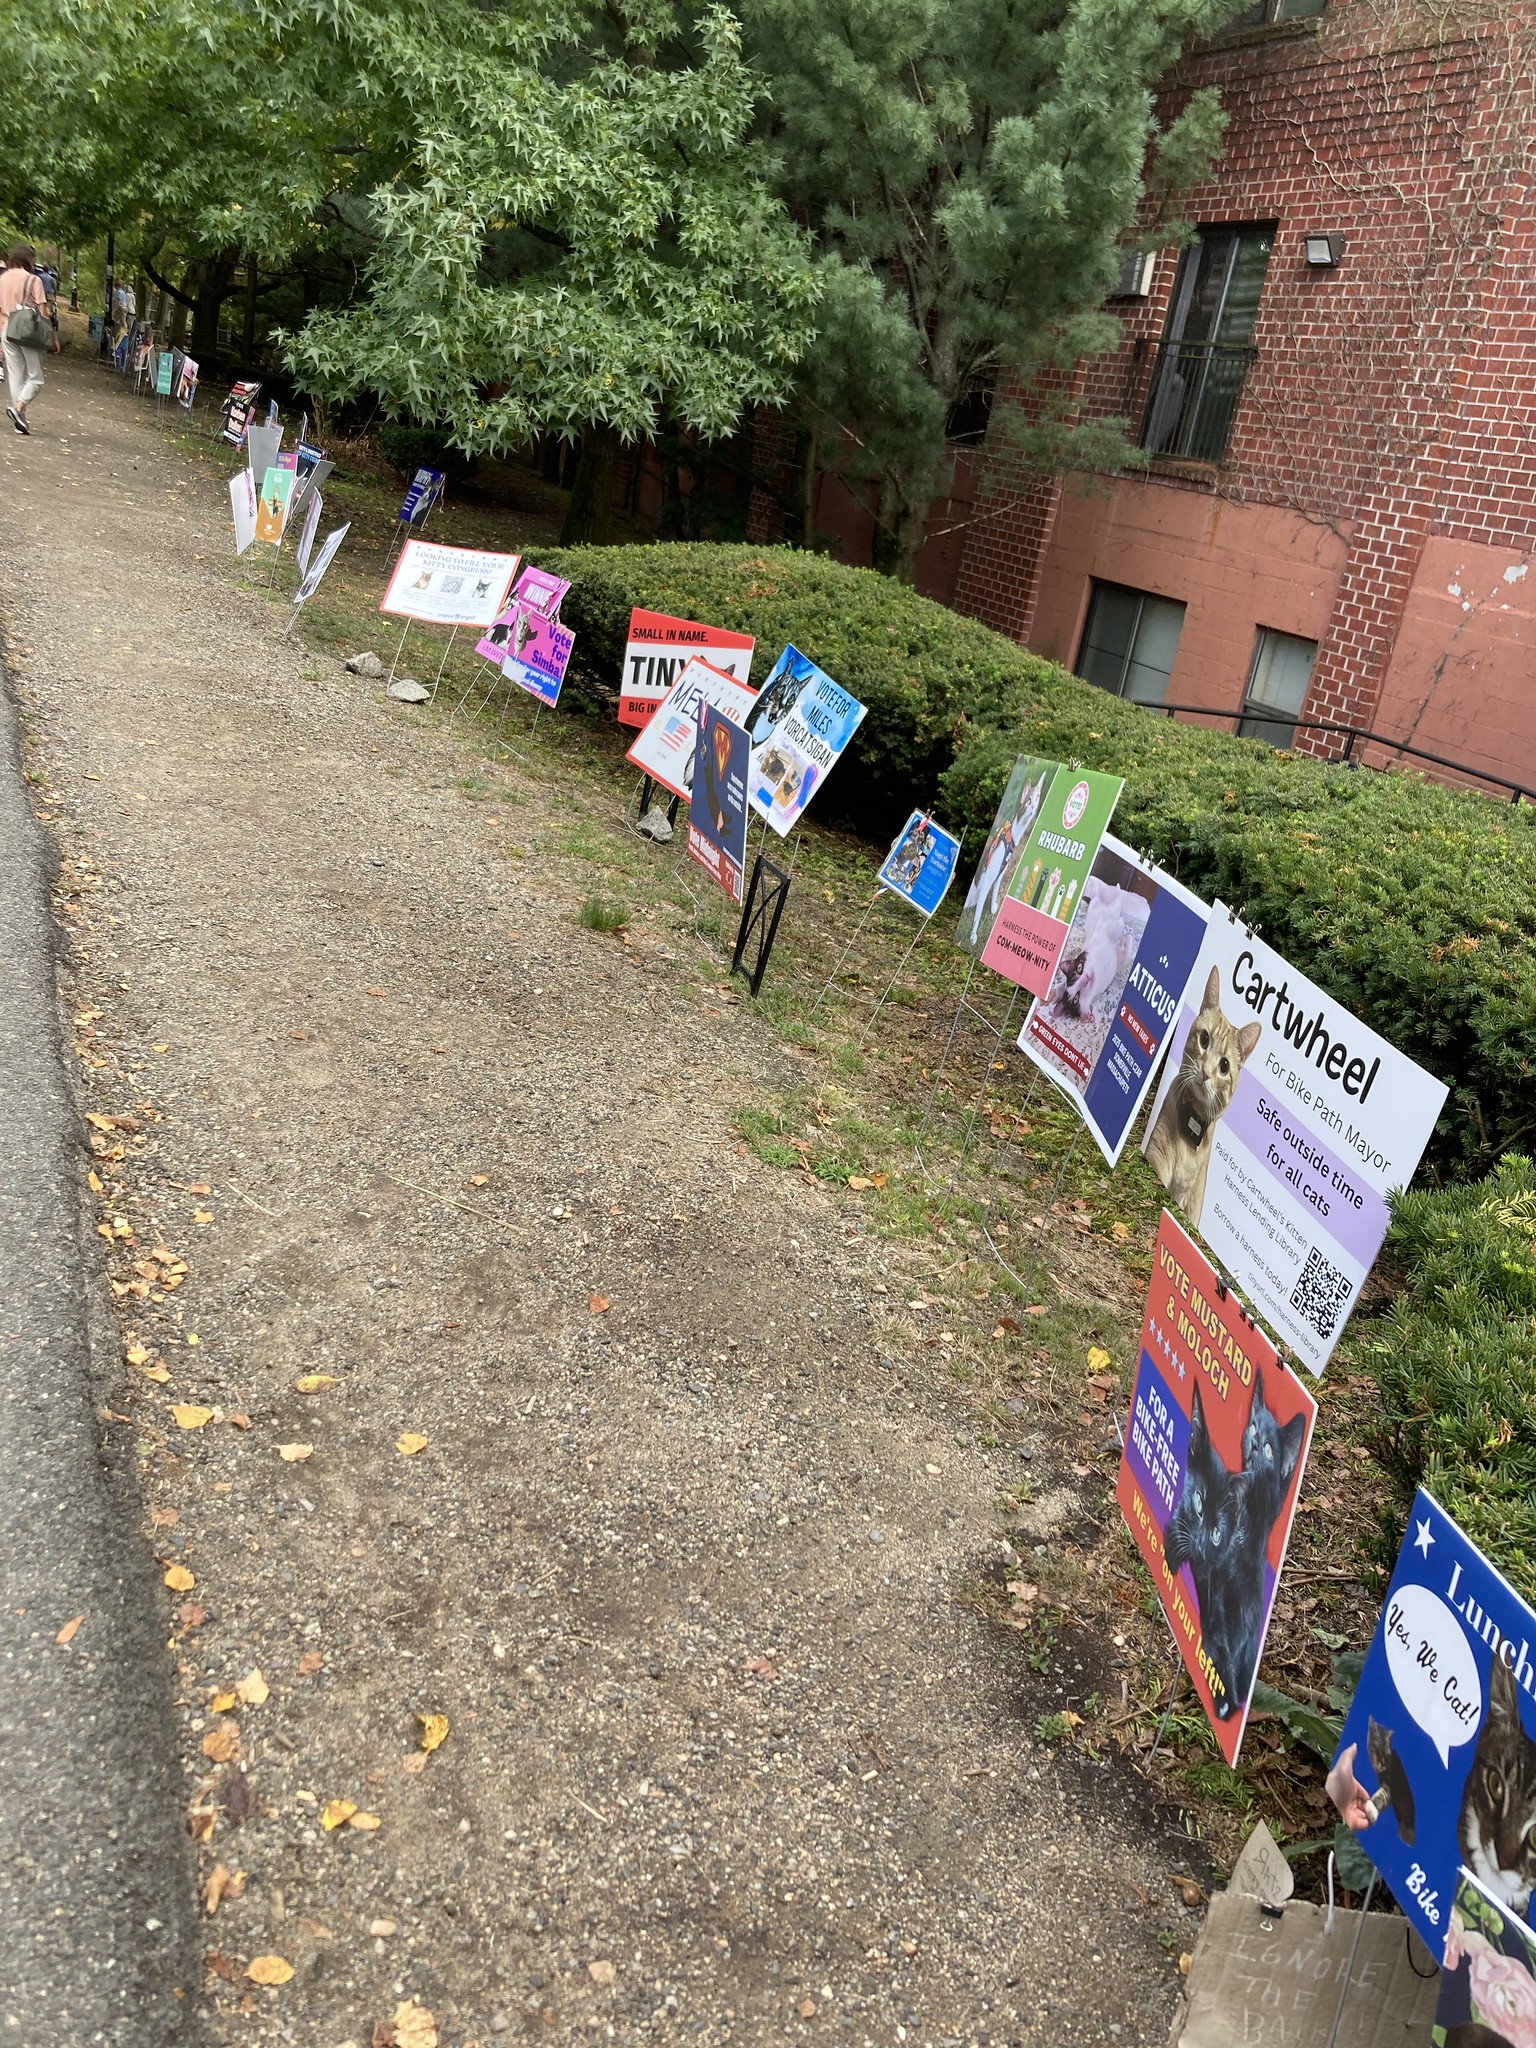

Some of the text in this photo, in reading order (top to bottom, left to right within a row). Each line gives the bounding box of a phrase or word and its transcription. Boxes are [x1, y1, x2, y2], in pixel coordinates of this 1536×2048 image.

[415, 551, 452, 562] LOOKING
[464, 558, 480, 566] FILL
[481, 560, 505, 569] YOUR
[422, 560, 446, 569] KITTY
[447, 563, 492, 574] CONGRESS!
[531, 650, 564, 678] Simba!
[549, 625, 572, 648] Vote
[552, 645, 567, 663] for
[632, 627, 709, 642] SMALL IN NAME.
[628, 701, 645, 713] BIG
[806, 706, 832, 735] MILES
[816, 680, 851, 719] VOTE FOR
[783, 716, 834, 769] VORCATSIGAN
[1037, 829, 1086, 861] RHUBARB
[997, 935, 1051, 972] COM-MEOW-NITY
[1002, 919, 1057, 952] HARNESS THE POWER OF
[1129, 963, 1175, 1024] ATTICUS
[1038, 1025, 1052, 1043] GREEN
[1052, 1036, 1064, 1052] EYES
[1077, 1057, 1085, 1070] LIE
[1232, 951, 1381, 1104] Cartwheel
[1125, 1051, 1135, 1067] PATH
[1266, 1052, 1391, 1173] For Bike Path Mayor
[1256, 1099, 1364, 1210] Safe outside time
[1266, 1144, 1331, 1217] for all cats
[1215, 1142, 1308, 1249] Paid for by Cartwheel's Kitten
[1224, 1174, 1301, 1265] Harness Lending Library
[1213, 1203, 1288, 1296] Borrow a harness today!
[1159, 1243, 1253, 1388] VOTE MUSTARD
[1248, 1272, 1320, 1360] tinyurl.com/harness-library
[1166, 1297, 1231, 1402] & MOLOCH
[1135, 1395, 1180, 1487] BIKE-FREE
[1148, 1385, 1174, 1444] FOR A
[1132, 1422, 1174, 1512] BIKE PATH
[1132, 1490, 1158, 1553] We're
[1171, 1590, 1196, 1643] your
[1195, 1635, 1225, 1698] left!"
[1445, 1559, 1536, 1703] Lunch
[1388, 1603, 1480, 1725] Yes, We Cat!
[1405, 1863, 1441, 1926] Bike
[1228, 1933, 1388, 1988] IGNORE
[1235, 1974, 1319, 2010] THE
